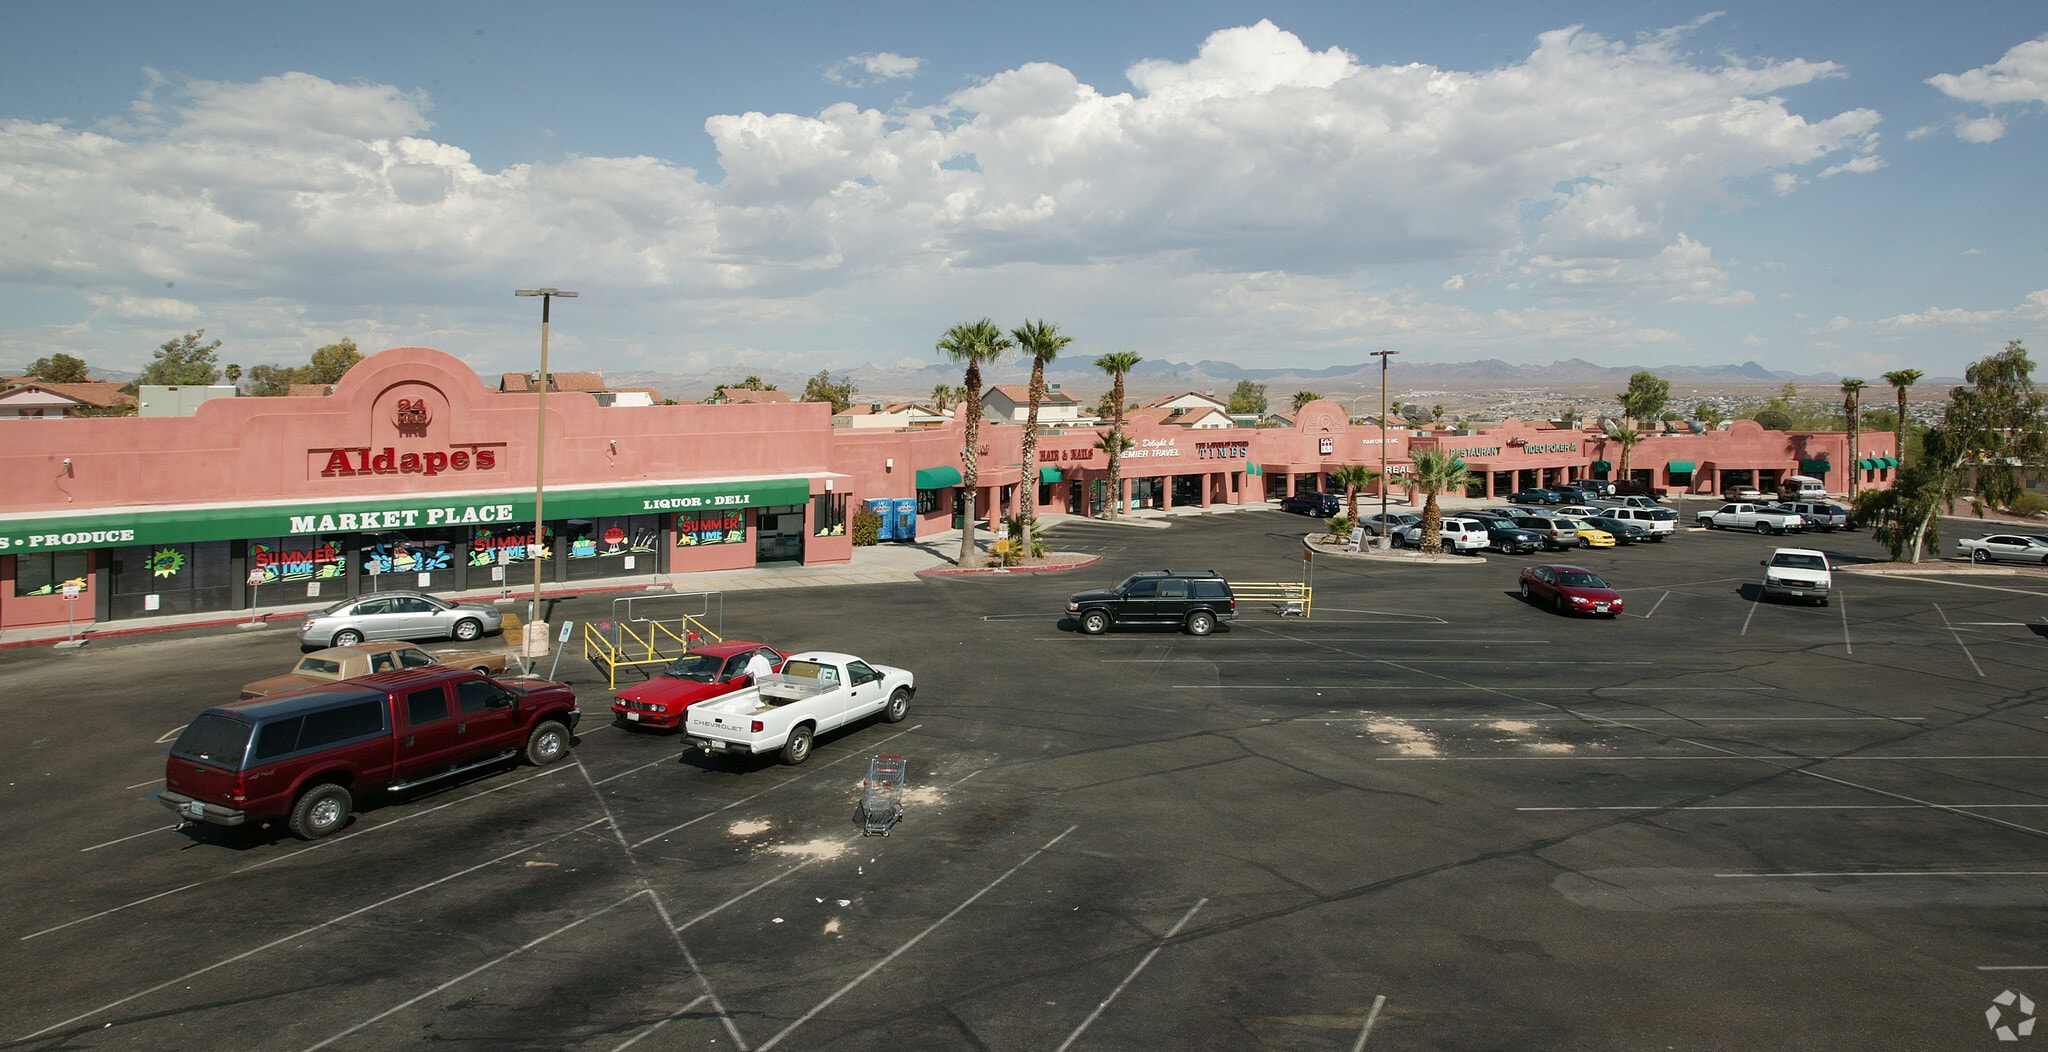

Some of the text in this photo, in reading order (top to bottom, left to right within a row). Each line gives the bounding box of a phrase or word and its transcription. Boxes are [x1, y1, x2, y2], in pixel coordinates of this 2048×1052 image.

[398, 399, 426, 412] 24
[398, 413, 427, 424] HRS
[1039, 450, 1060, 462] HAIR
[1070, 448, 1094, 460] NAILS
[1152, 449, 1180, 457] TRAVEL
[1200, 447, 1247, 459] TIMES
[1449, 447, 1501, 458] RESTAURANT
[1523, 443, 1570, 454] VIDEO POKER
[322, 444, 496, 476] Aldape's
[1385, 466, 1412, 474] REAL
[643, 494, 750, 510] LIQUOR DELI
[290, 505, 513, 533] MARKET PLACE
[682, 517, 739, 533] SUMMER
[28, 530, 135, 547] PRODUCE
[256, 548, 337, 567] SUMMER
[694, 719, 743, 731] CHEVROLET
